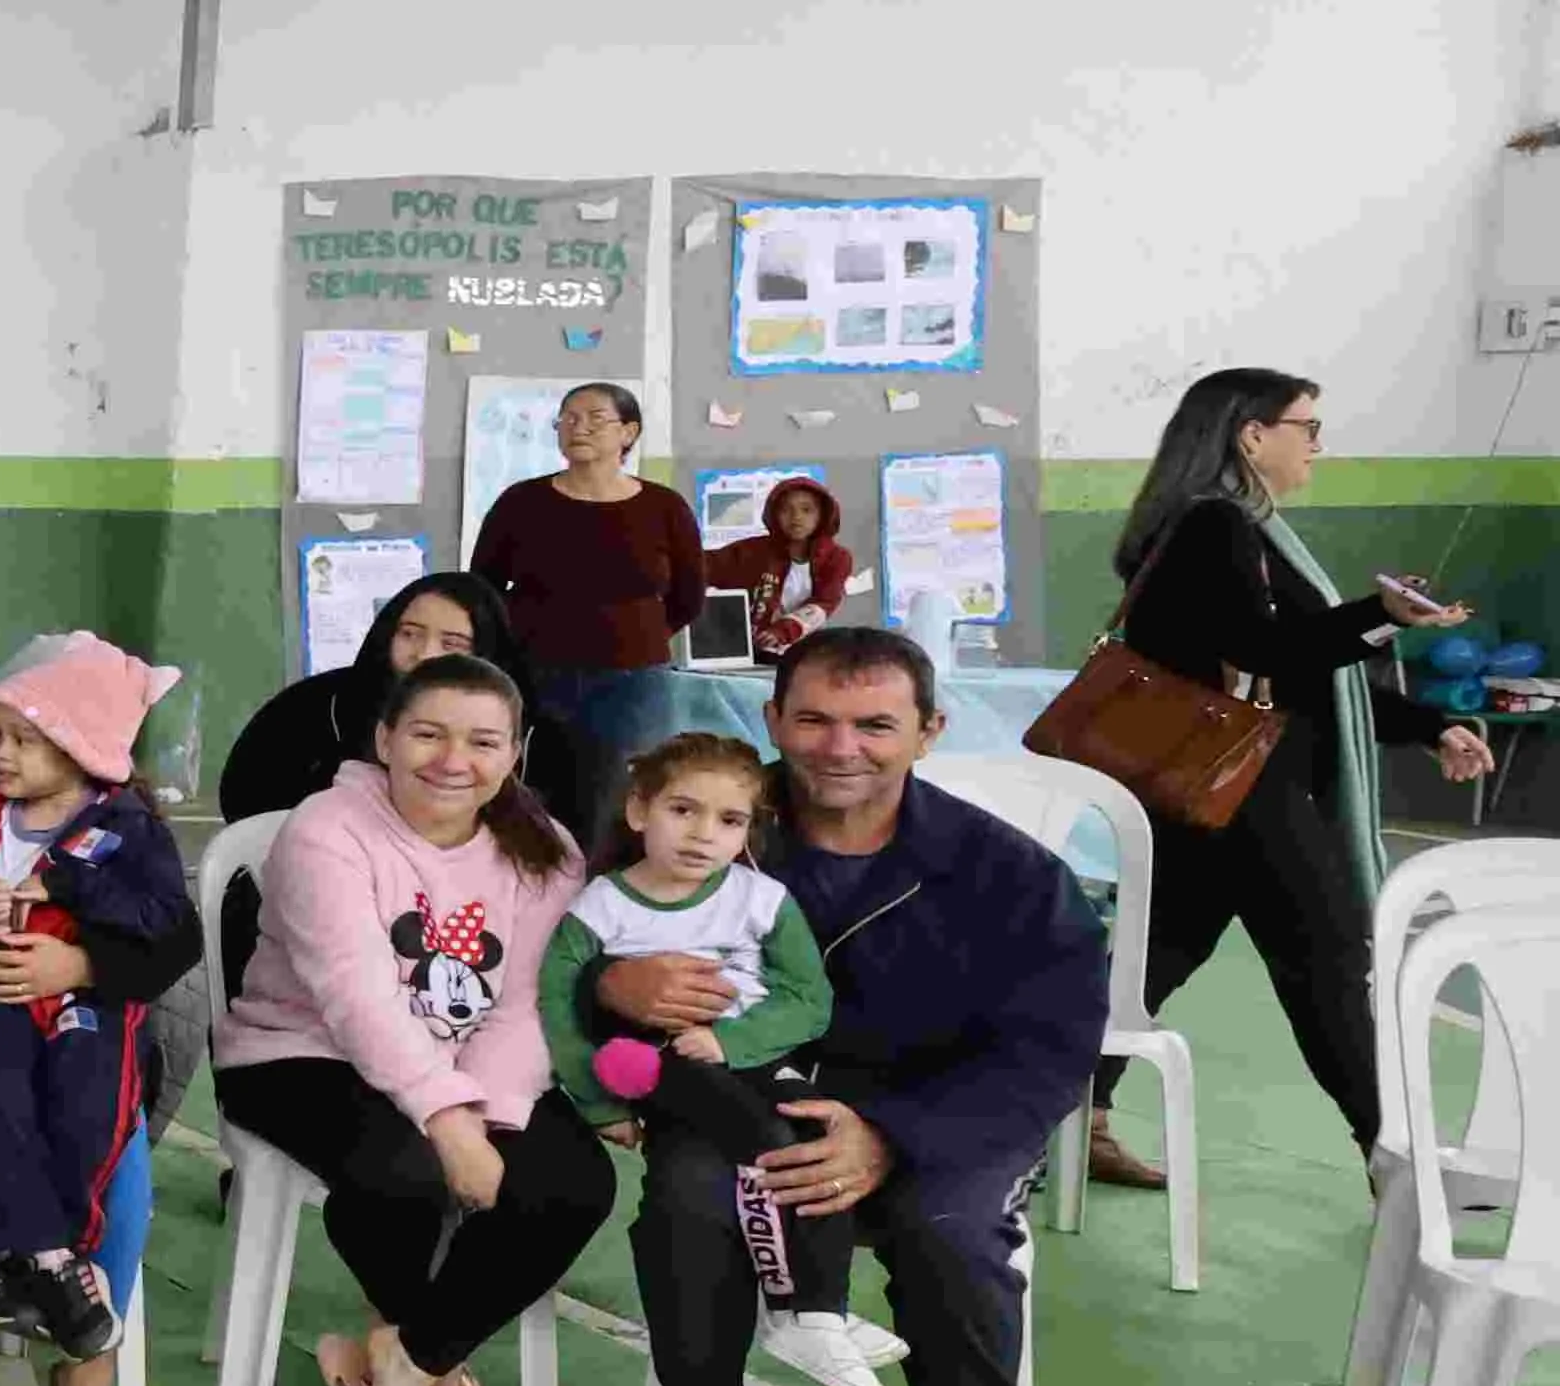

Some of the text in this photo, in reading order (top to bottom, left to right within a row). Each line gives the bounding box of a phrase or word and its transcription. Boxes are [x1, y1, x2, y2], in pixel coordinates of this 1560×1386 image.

[391, 190, 545, 226] POR QUE
[306, 268, 433, 301] SEMPRE
